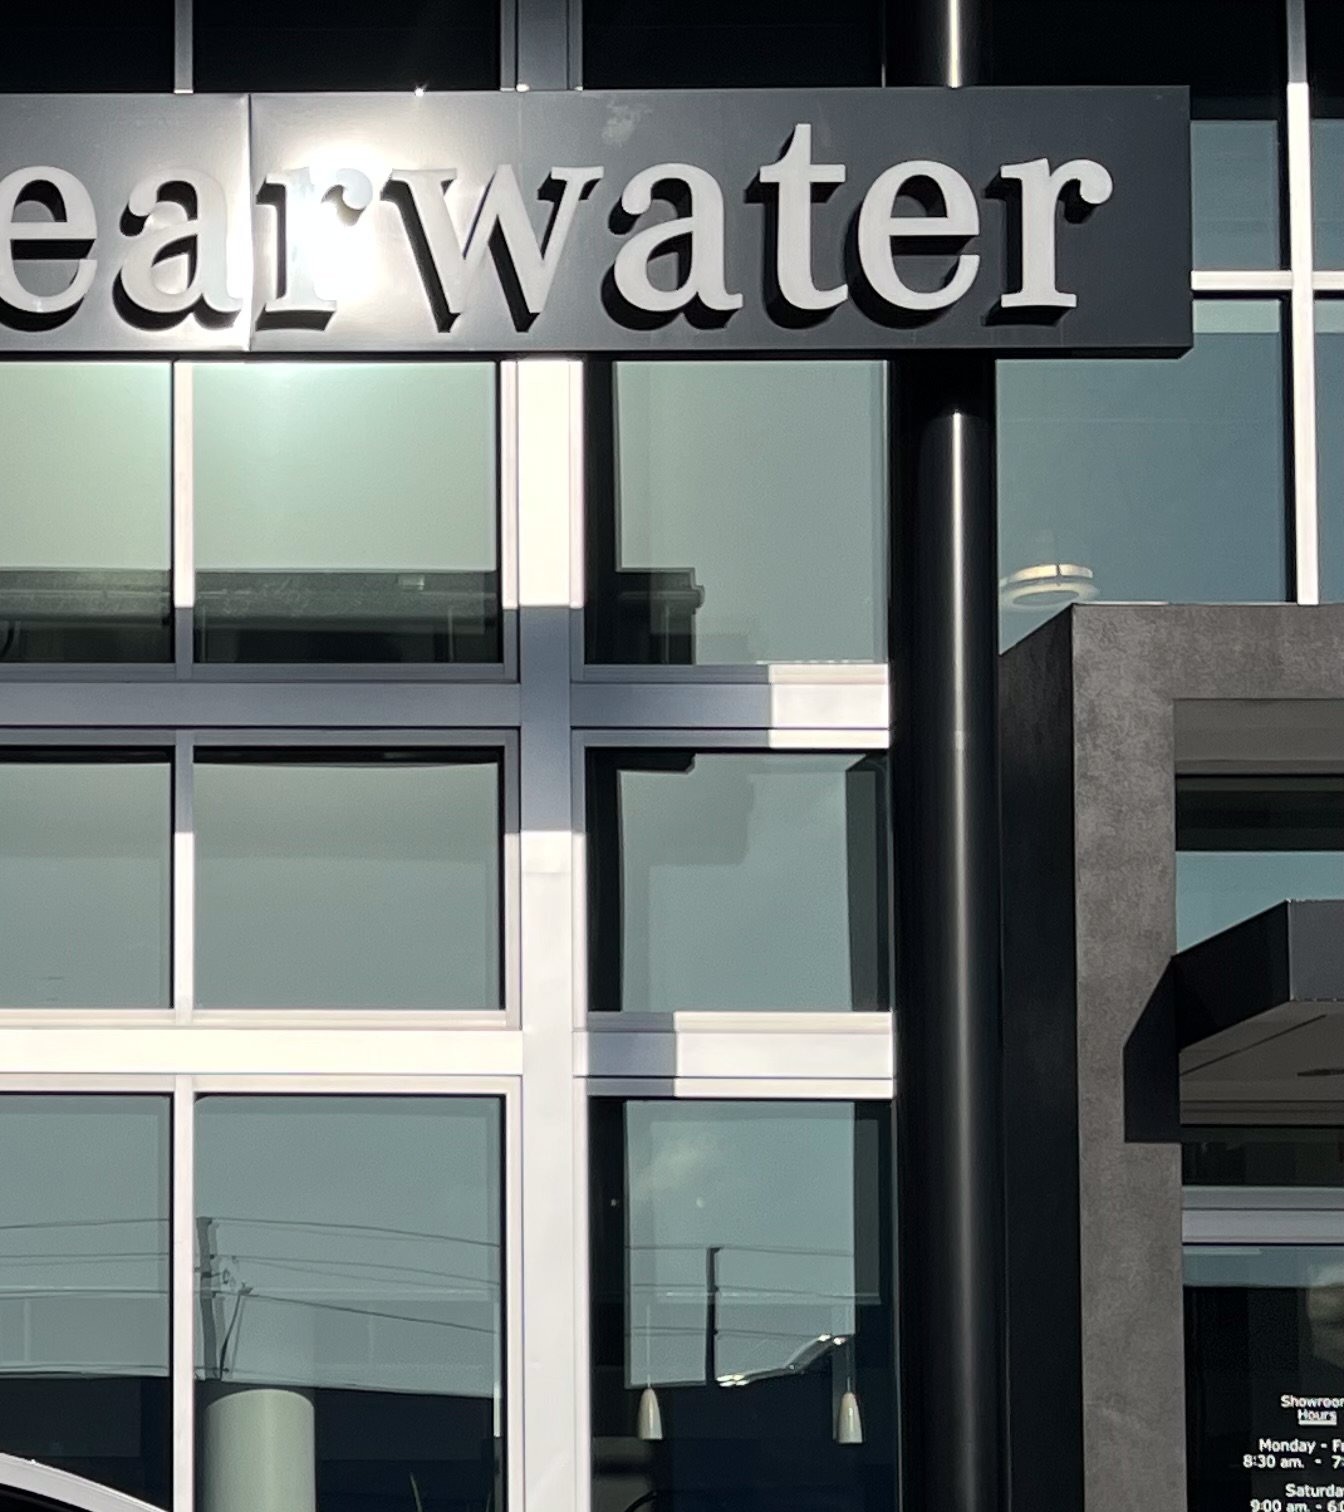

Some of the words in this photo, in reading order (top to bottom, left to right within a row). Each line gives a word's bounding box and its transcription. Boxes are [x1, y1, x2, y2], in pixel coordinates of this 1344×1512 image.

[1297, 1408, 1338, 1422] Hours
[1258, 1438, 1316, 1455] Monday
[1242, 1454, 1276, 1469] 8:30
[1284, 1482, 1344, 1498] Saturda
